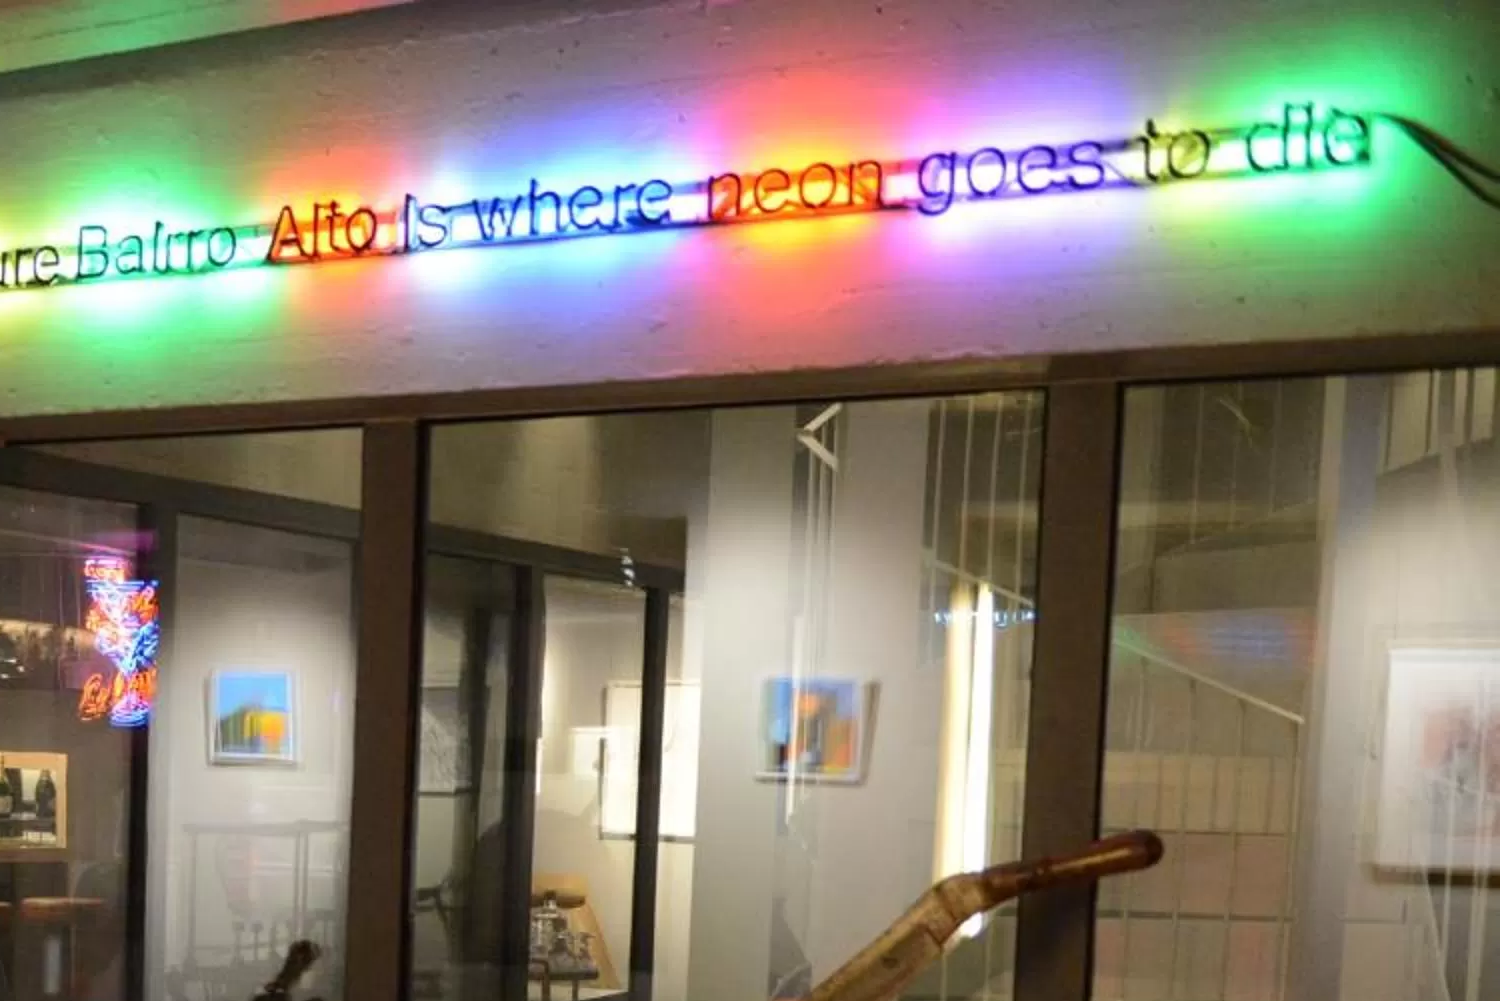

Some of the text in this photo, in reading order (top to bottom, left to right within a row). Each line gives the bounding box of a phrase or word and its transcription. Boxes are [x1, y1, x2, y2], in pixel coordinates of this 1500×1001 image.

[76, 220, 237, 279] Bairro
[265, 200, 378, 263] Alto
[471, 178, 673, 240] where
[707, 160, 883, 219] neon
[917, 140, 1105, 216] goes
[1138, 118, 1211, 182] to
[1246, 101, 1370, 172] die
